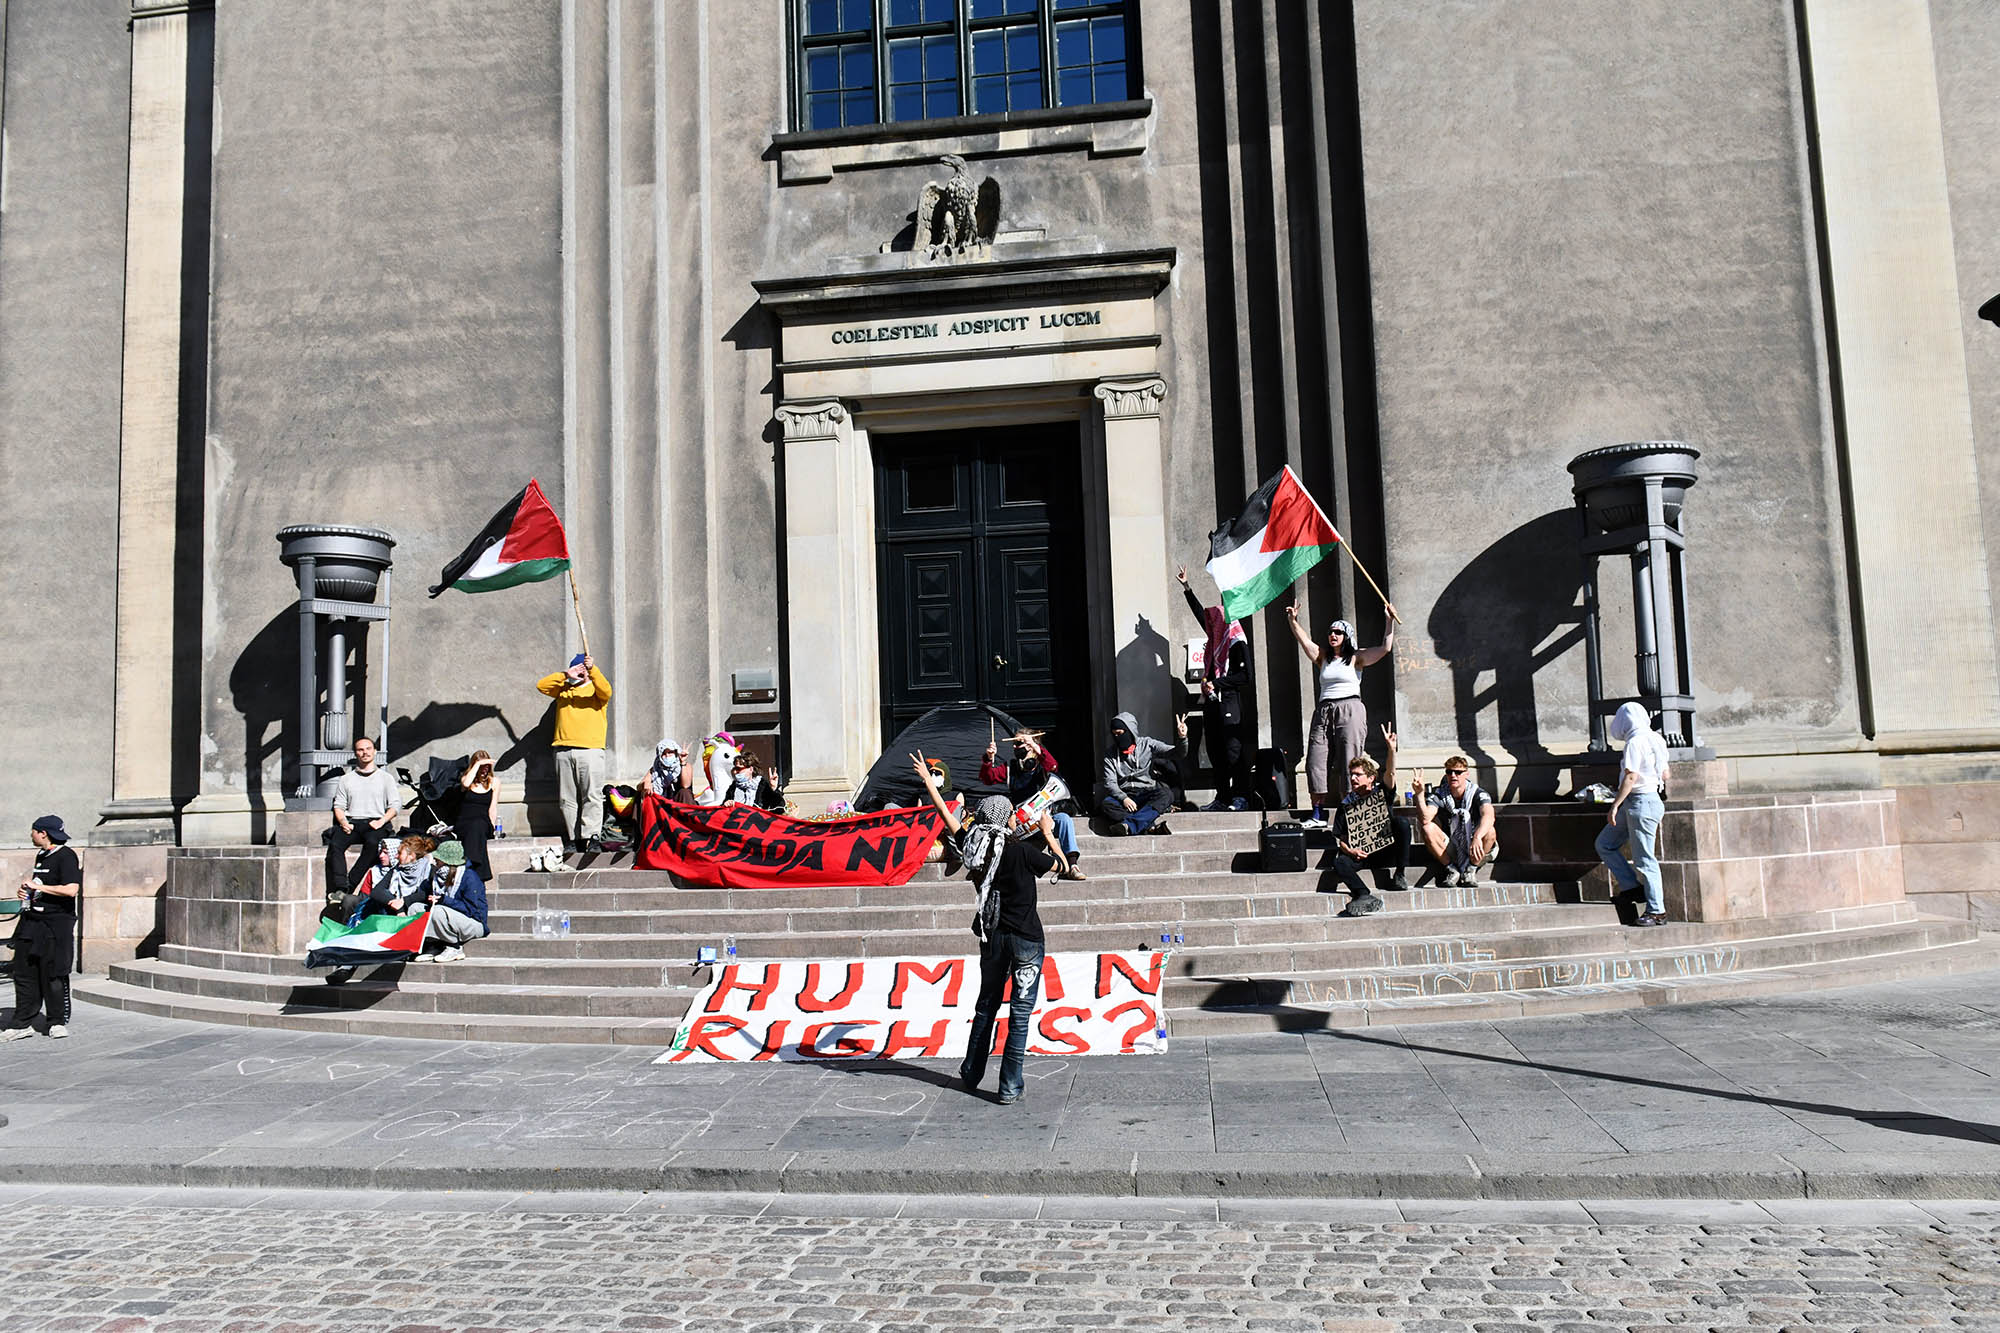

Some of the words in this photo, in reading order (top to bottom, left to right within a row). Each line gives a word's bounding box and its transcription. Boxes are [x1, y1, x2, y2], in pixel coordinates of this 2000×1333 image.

[831, 322, 938, 345] COELESTEM
[947, 316, 1030, 336] ADSPICIT
[1039, 310, 1101, 330] LUCEM
[722, 807, 777, 834] EN
